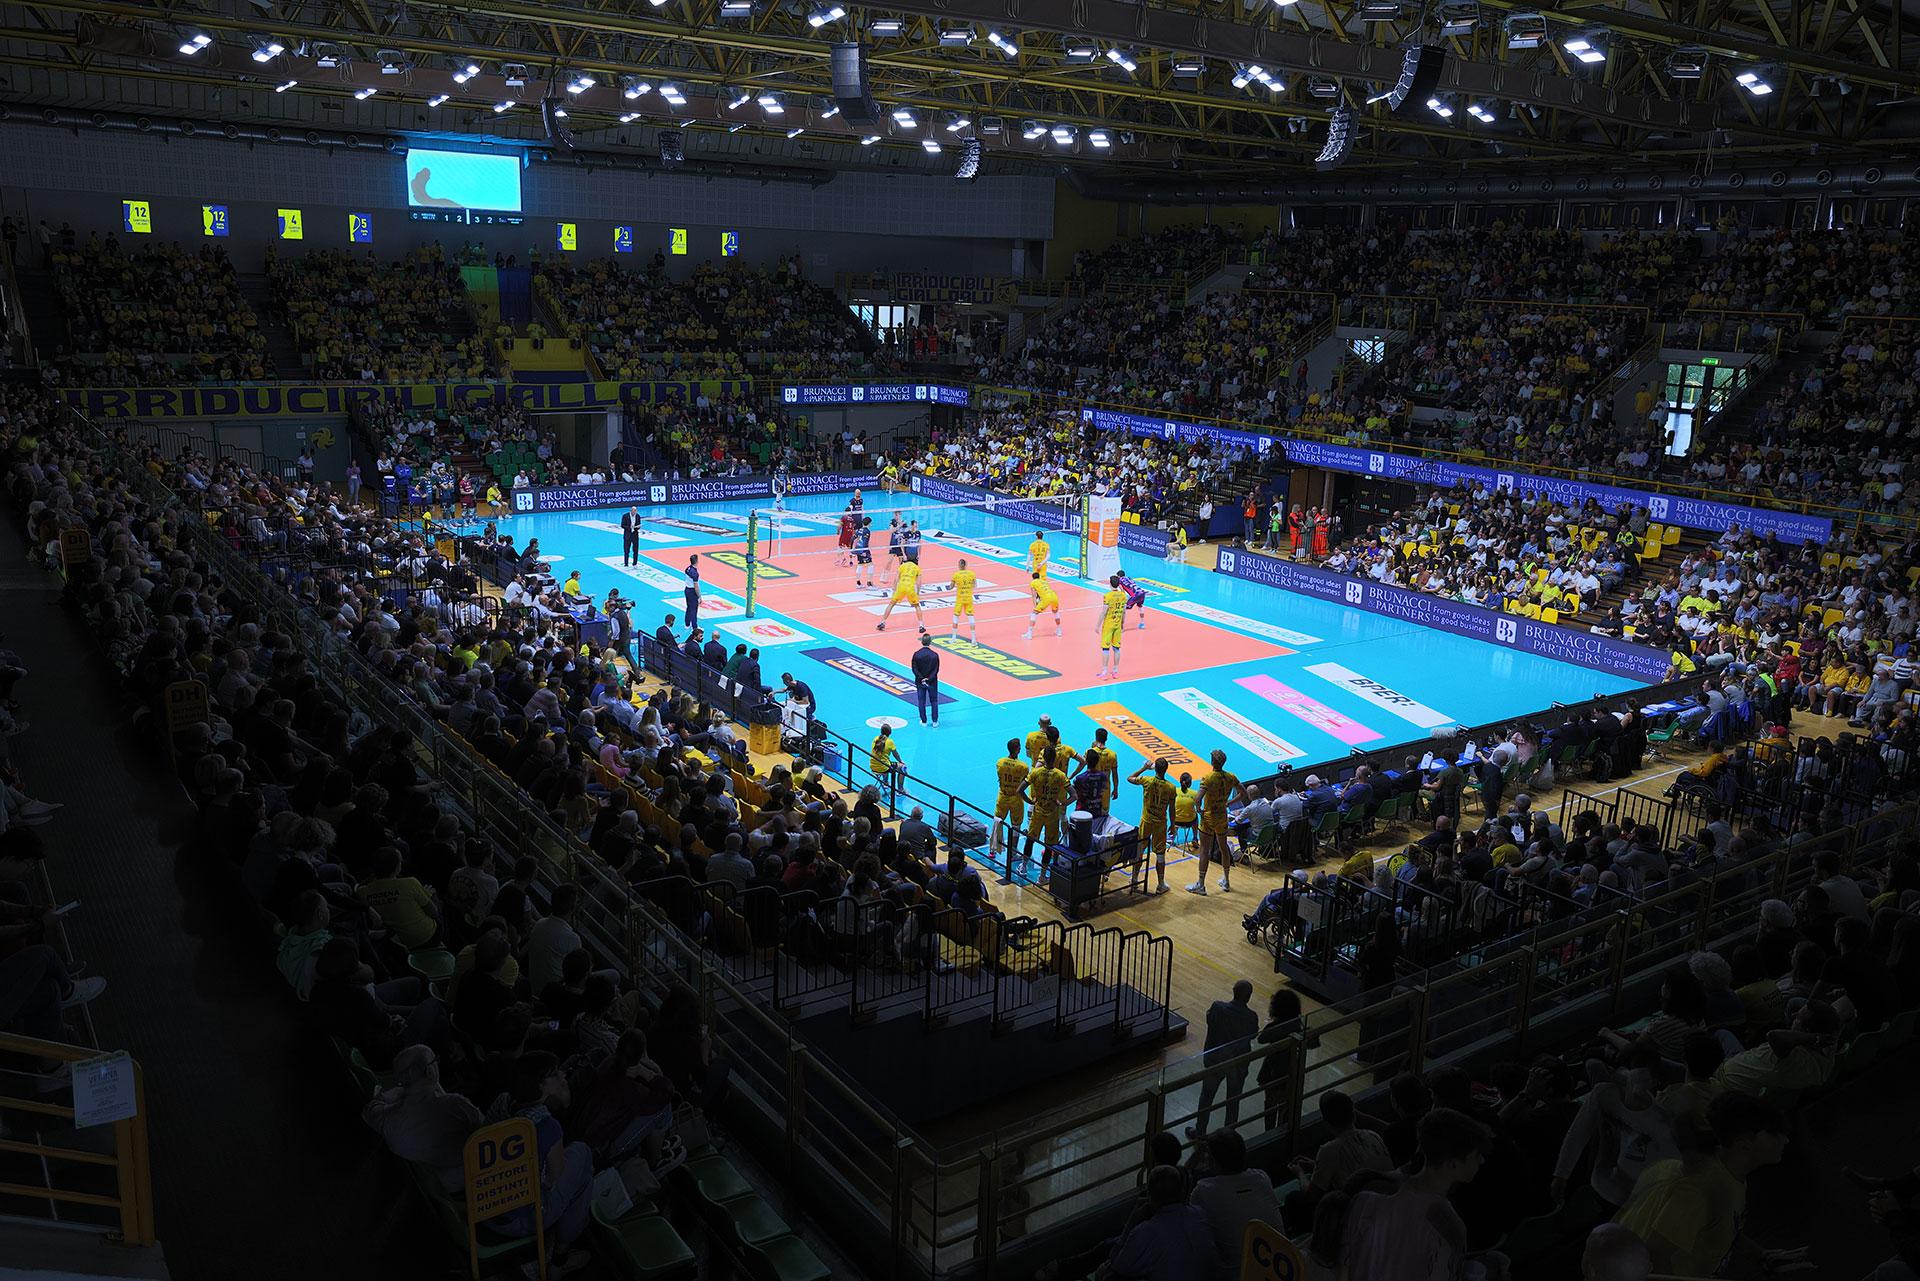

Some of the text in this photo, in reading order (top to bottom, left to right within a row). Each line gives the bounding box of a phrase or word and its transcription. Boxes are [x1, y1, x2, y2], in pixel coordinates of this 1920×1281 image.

[134, 207, 146, 217] 12
[214, 211, 225, 222] 12
[804, 387, 846, 395] BRUNACCI
[870, 386, 910, 394] BRUNACCI
[1096, 412, 1130, 425] BRUNACCI
[1180, 425, 1219, 439] BRUNACCI
[1322, 449, 1363, 461] From good ideas
[1328, 457, 1341, 465] good
[1390, 456, 1443, 475] BRUNACCI
[791, 475, 838, 486] BRUNACCI
[852, 476, 865, 484] good
[1444, 468, 1458, 477] From
[1460, 471, 1475, 480] good
[1476, 473, 1493, 483] ideas
[672, 482, 724, 494] BRUNACCI
[740, 483, 753, 491] good
[754, 481, 768, 489] ideas
[791, 484, 839, 494] &PARTNERS
[858, 480, 879, 488] business
[923, 479, 955, 495] BRUNACCI
[1521, 477, 1583, 496] BRUNACCI
[540, 489, 597, 501] BRUNACCI
[615, 490, 630, 499] good
[631, 489, 647, 497] ideas
[672, 491, 724, 502] &PARTNERS
[731, 489, 745, 497] good
[746, 487, 768, 495] business
[1584, 490, 1603, 499] From
[1604, 493, 1622, 502] good
[1623, 495, 1642, 505] ideas
[540, 499, 598, 510] &PARTNERS
[606, 497, 621, 505] good
[622, 495, 647, 503] business
[1676, 501, 1752, 523] BRUNACCI
[1754, 516, 1825, 534] From good ideas
[1128, 532, 1139, 540] From
[1141, 535, 1152, 543] good
[1153, 538, 1165, 546] ideas
[1787, 530, 1824, 543] business
[1133, 540, 1144, 548] good
[1145, 543, 1165, 552] business
[1240, 556, 1292, 578] BRUNACCI
[1240, 568, 1292, 587] &PARTNERS
[1293, 572, 1341, 589] From good ideas
[1300, 581, 1315, 591] good
[1316, 585, 1341, 597] business
[1369, 587, 1431, 613] BRUNACCI
[1368, 599, 1430, 623] &PARTNERS
[1433, 606, 1491, 627] From good ideas
[1441, 616, 1458, 627] good
[1460, 620, 1490, 635] business
[1525, 625, 1601, 654] BRUNACCI
[1604, 648, 1626, 659] From
[1628, 653, 1650, 665] good
[1604, 657, 1666, 678] to good busine
[171, 685, 201, 704] DH
[1105, 714, 1192, 766] esclamativa
[479, 1134, 525, 1169] DG
[476, 1163, 529, 1188] SETTORE
[476, 1178, 529, 1201] DISTINTI
[478, 1189, 529, 1212] NUMERATI
